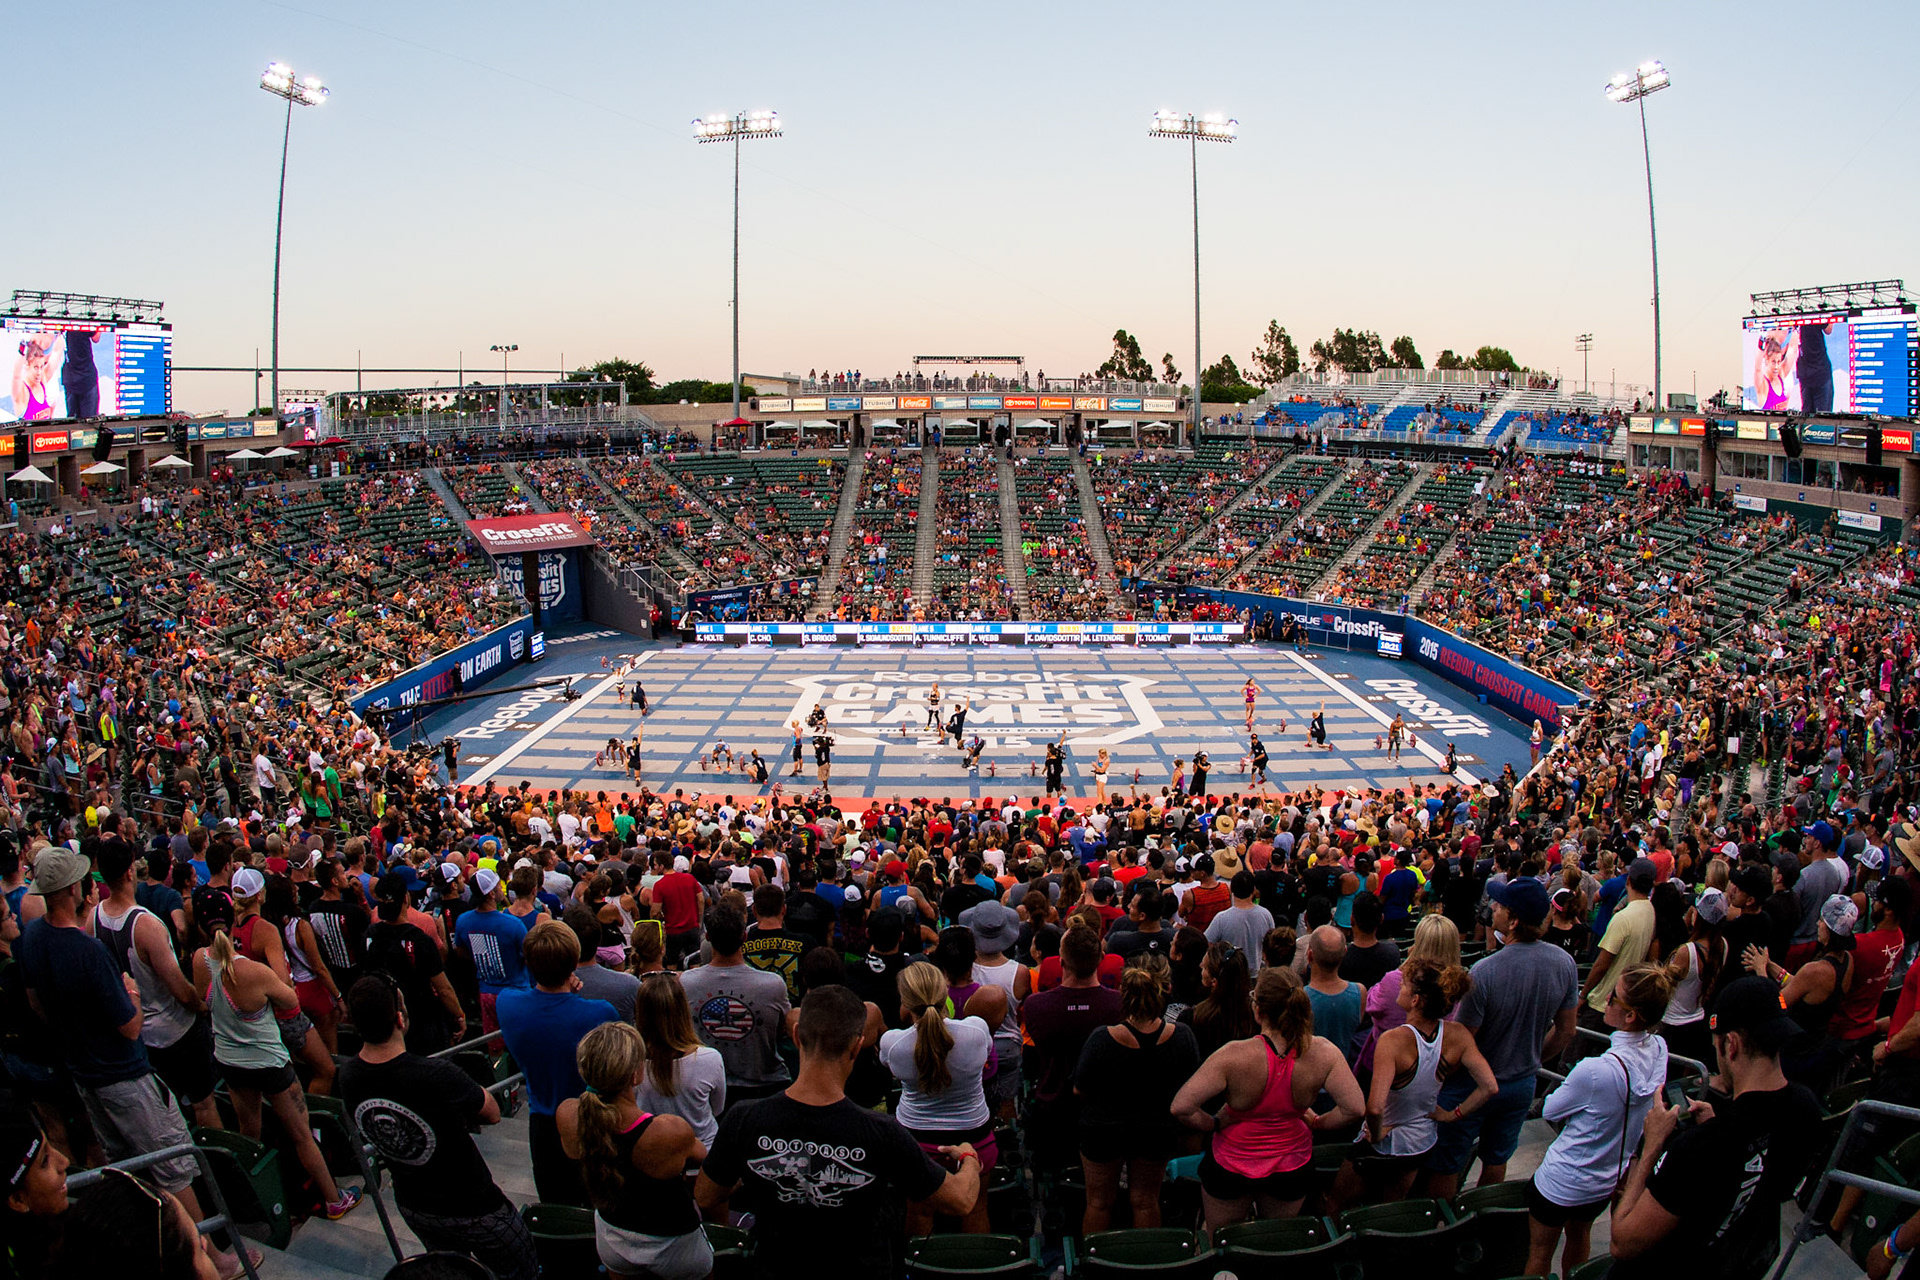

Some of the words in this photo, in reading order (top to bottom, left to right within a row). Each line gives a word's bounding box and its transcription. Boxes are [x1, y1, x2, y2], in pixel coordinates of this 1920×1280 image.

[45, 436, 67, 445] TOYOTA
[1885, 434, 1910, 446] TOYOTA
[481, 522, 573, 541] CrossFit
[490, 539, 524, 547] FORGING
[547, 532, 578, 543] FITNESS
[1334, 615, 1386, 638] CrossFit
[979, 634, 999, 642] WEBB
[1092, 634, 1126, 642] LETENDRE
[1145, 634, 1172, 642] TOOMEY
[1201, 634, 1229, 642] ALVAREZ
[461, 659, 474, 682] ON
[475, 644, 501, 676] EARTH
[1420, 637, 1439, 660] 2015
[1440, 646, 1476, 680] REEBOK
[1475, 663, 1525, 703] CROSSFIT
[873, 671, 1075, 682] Reebok
[833, 682, 1123, 701] CrossFit
[453, 687, 567, 739] Reebok
[824, 703, 1123, 725] GAMES
[1364, 679, 1492, 738] CrossFit
[741, 937, 803, 954] PROGENEX
[757, 1135, 866, 1162] OUTCAST
